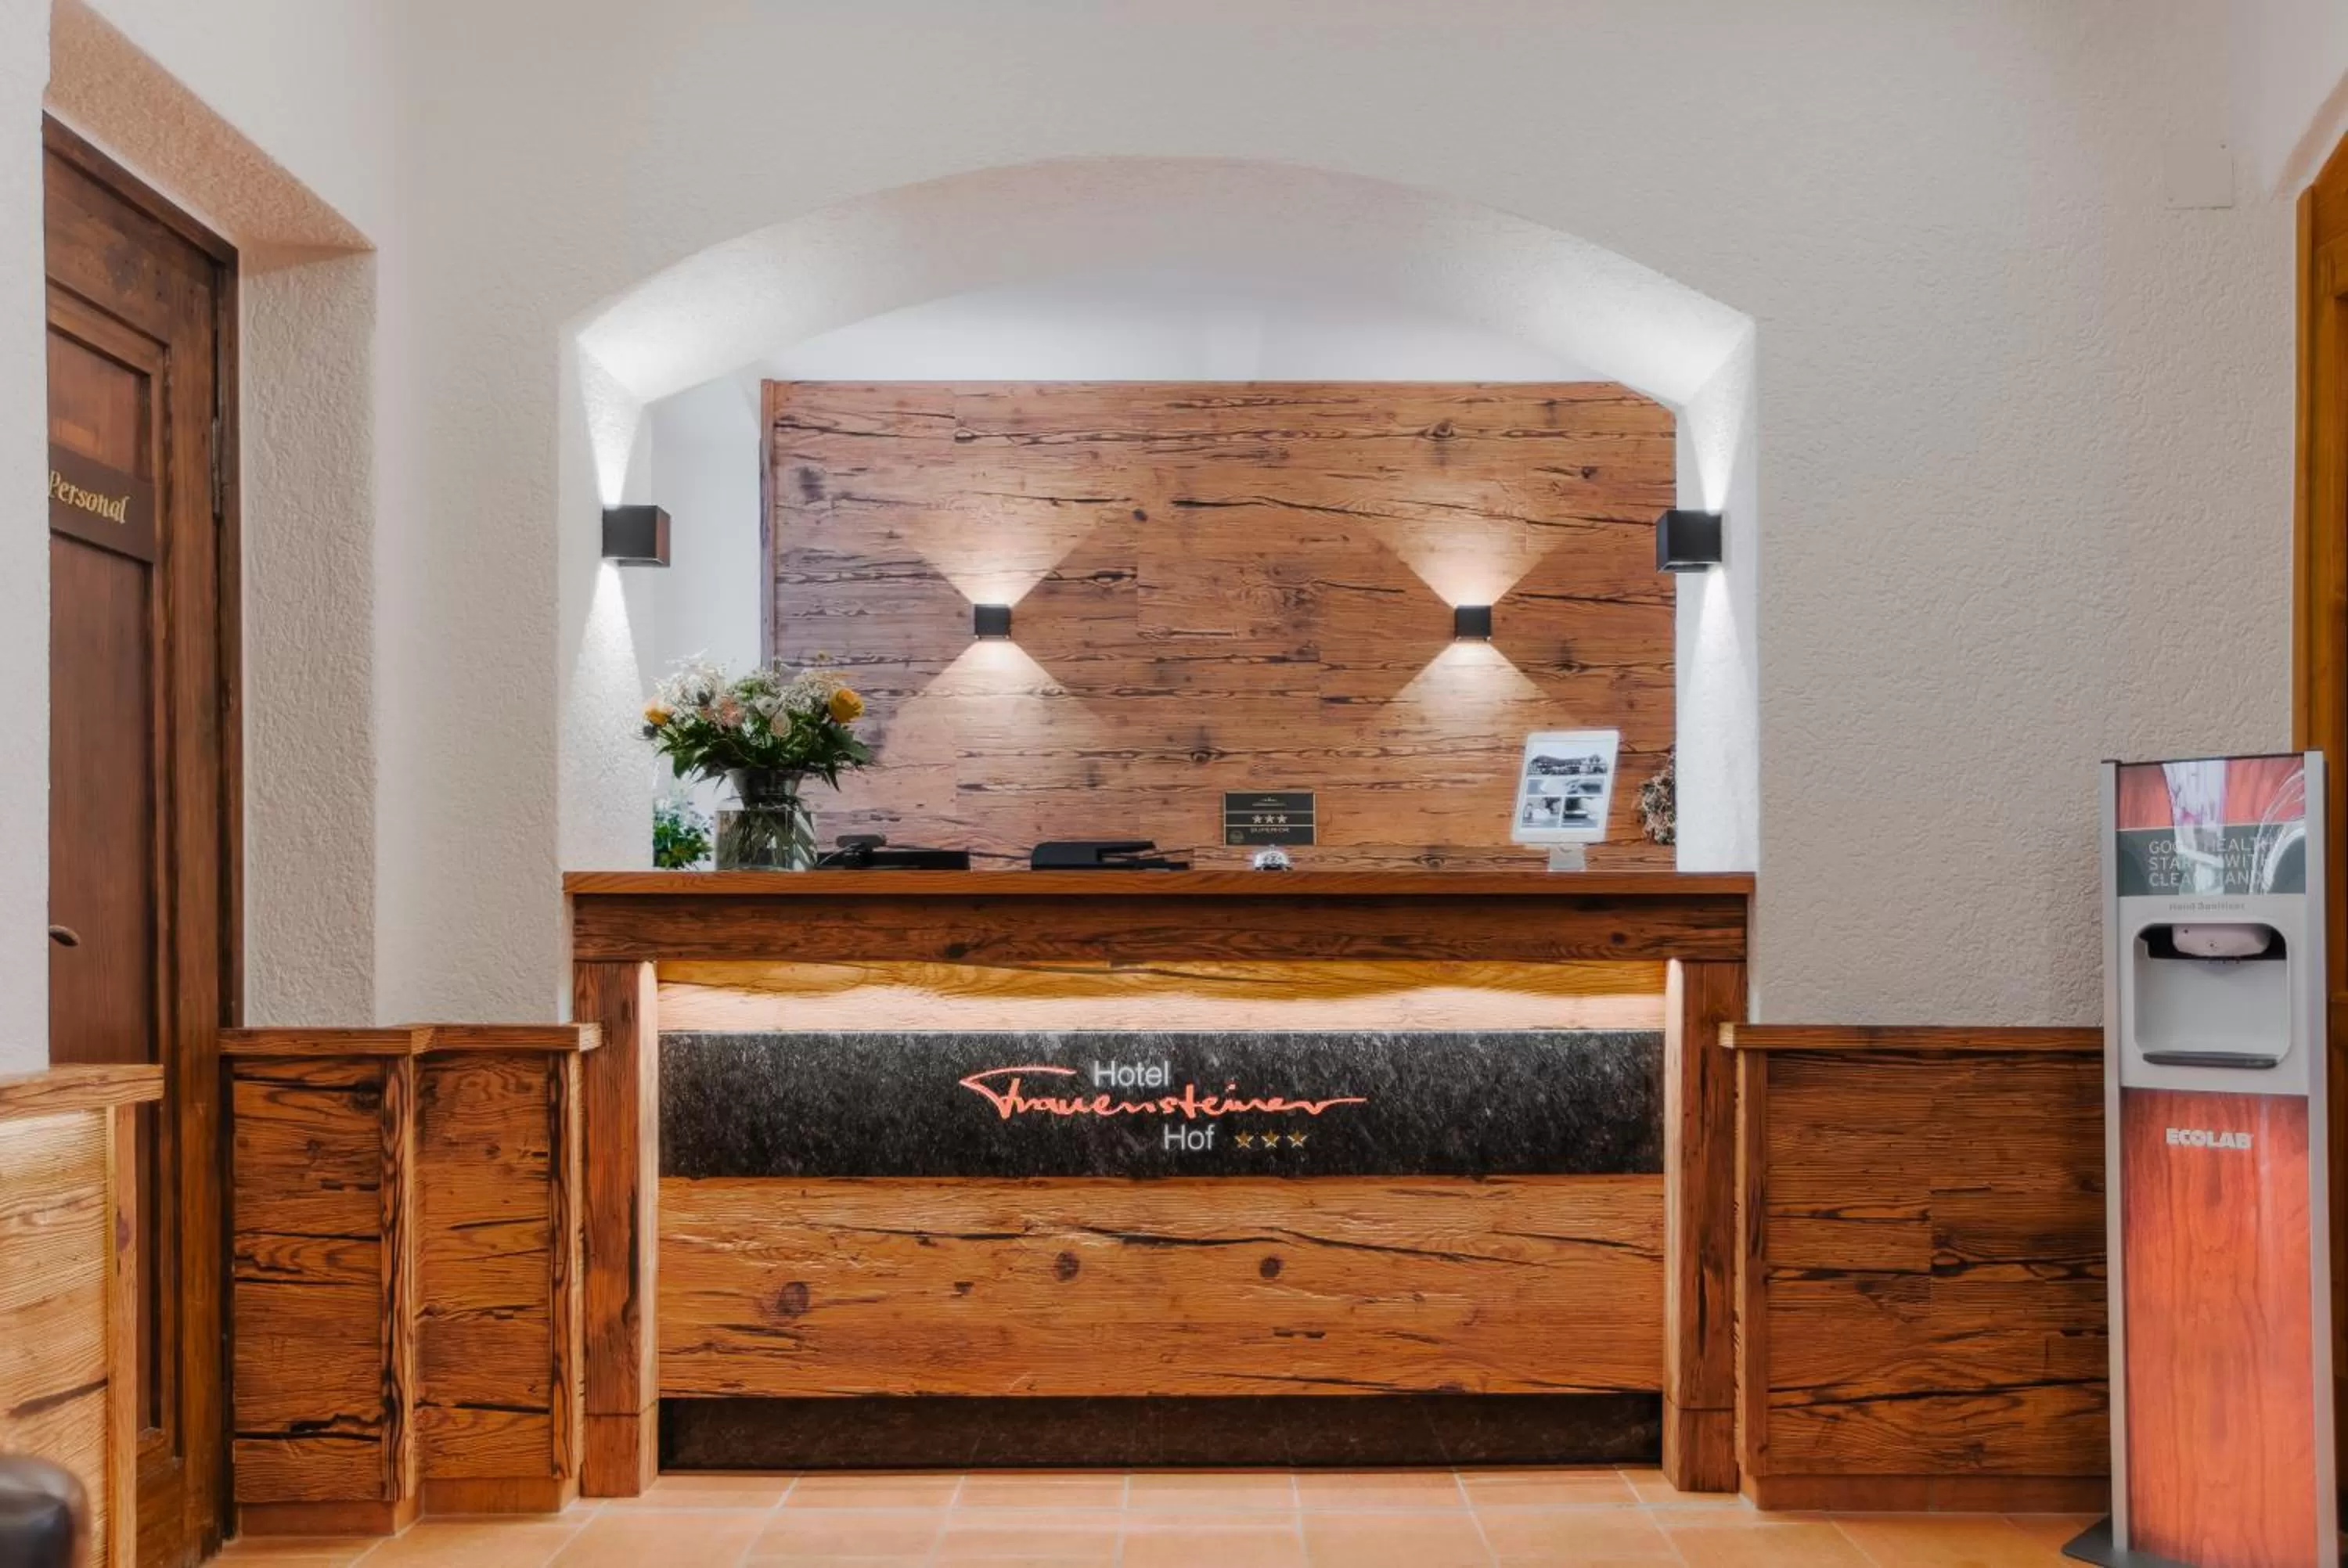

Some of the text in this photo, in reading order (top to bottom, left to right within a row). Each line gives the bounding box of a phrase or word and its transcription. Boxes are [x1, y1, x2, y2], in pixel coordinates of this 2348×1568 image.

[48, 470, 130, 523] Personal
[2148, 840, 2188, 854] GO
[2148, 856, 2196, 871] STAR
[2148, 872, 2198, 886] CLEA
[1094, 1060, 1170, 1087] Hotel
[1164, 1124, 1215, 1150] Hof
[2166, 1127, 2254, 1149] ECOLAB
